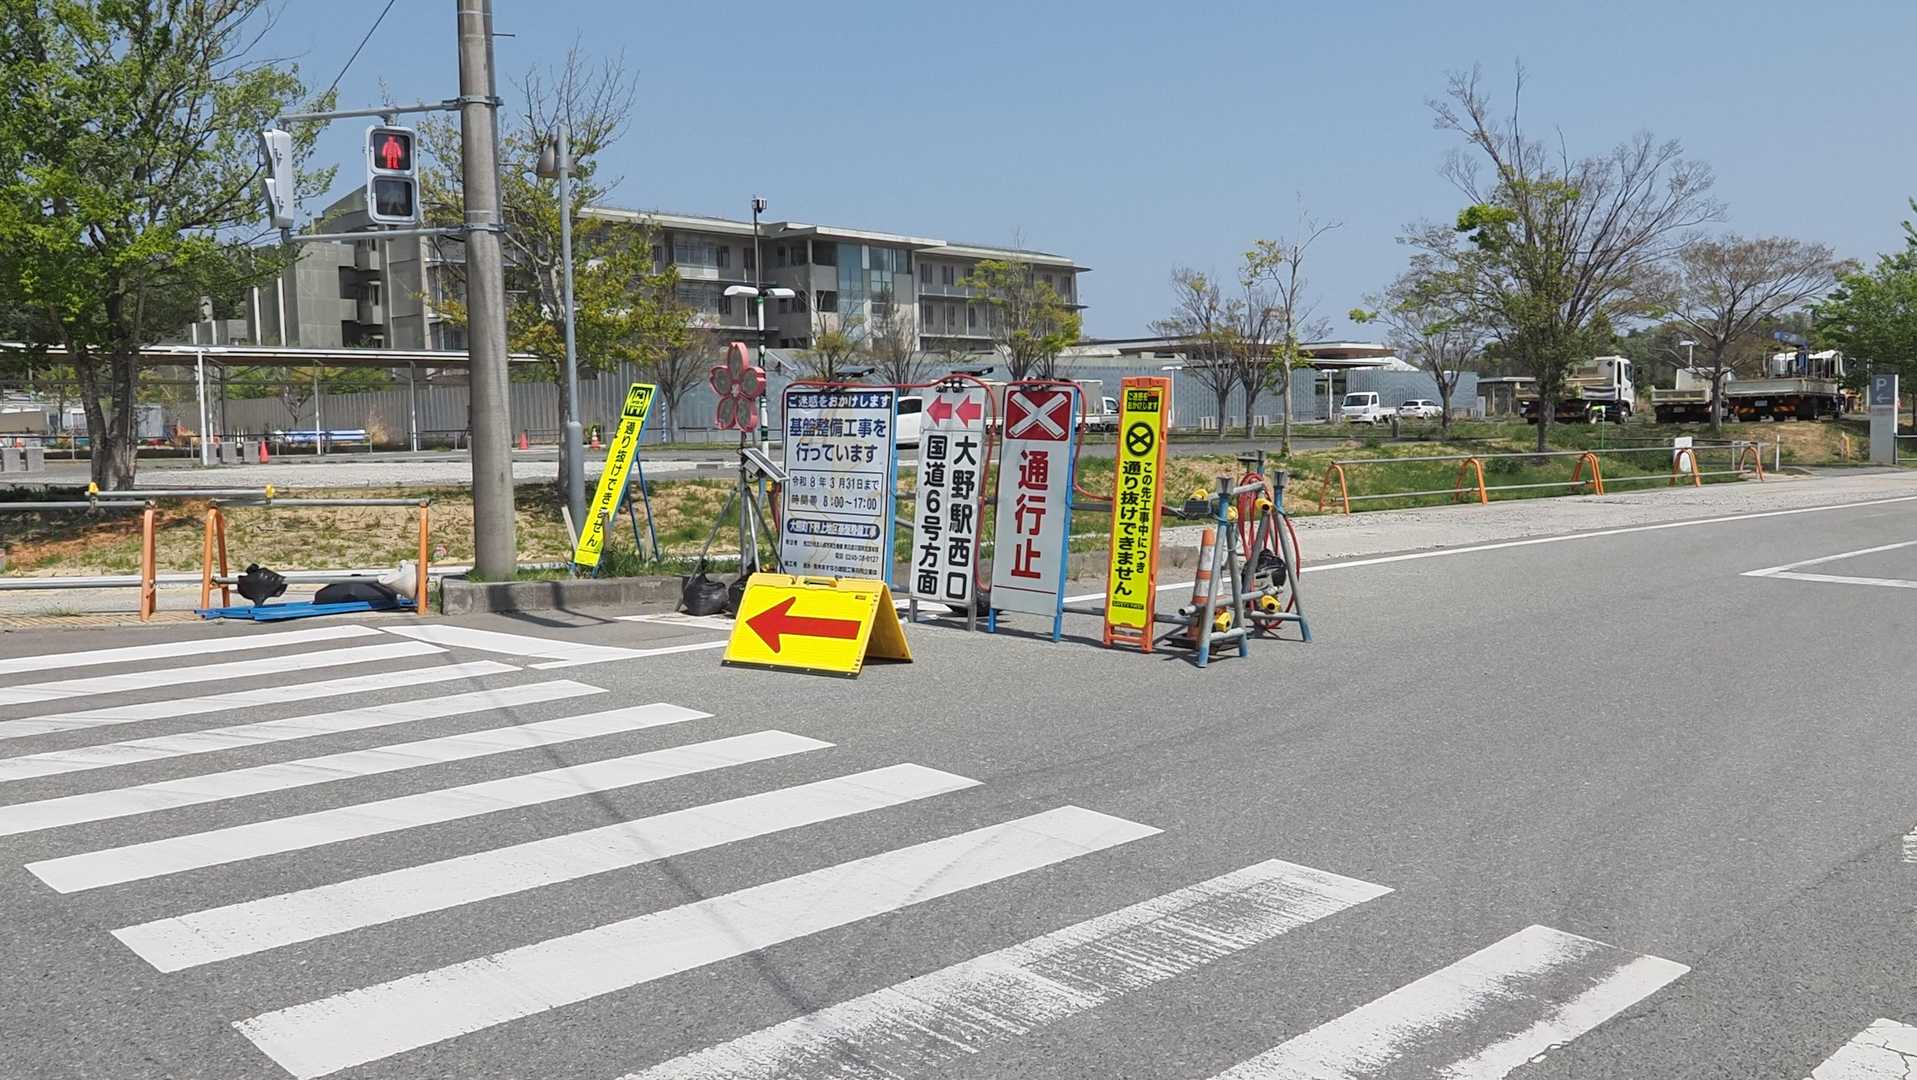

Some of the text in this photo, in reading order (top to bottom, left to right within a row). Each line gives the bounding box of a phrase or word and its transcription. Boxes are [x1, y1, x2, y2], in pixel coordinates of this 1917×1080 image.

[788, 394, 891, 408] ご迷惑をおかけします
[790, 417, 887, 438] 基盤整備工事を
[1876, 378, 1887, 391] P
[796, 443, 878, 463] 行っています
[917, 435, 948, 595] 国道6号方面
[946, 435, 978, 600] 大野駅西口
[1011, 450, 1049, 579] 通行止
[1114, 461, 1142, 596] 通り抜けできません
[1136, 462, 1153, 574] この先工事中につき
